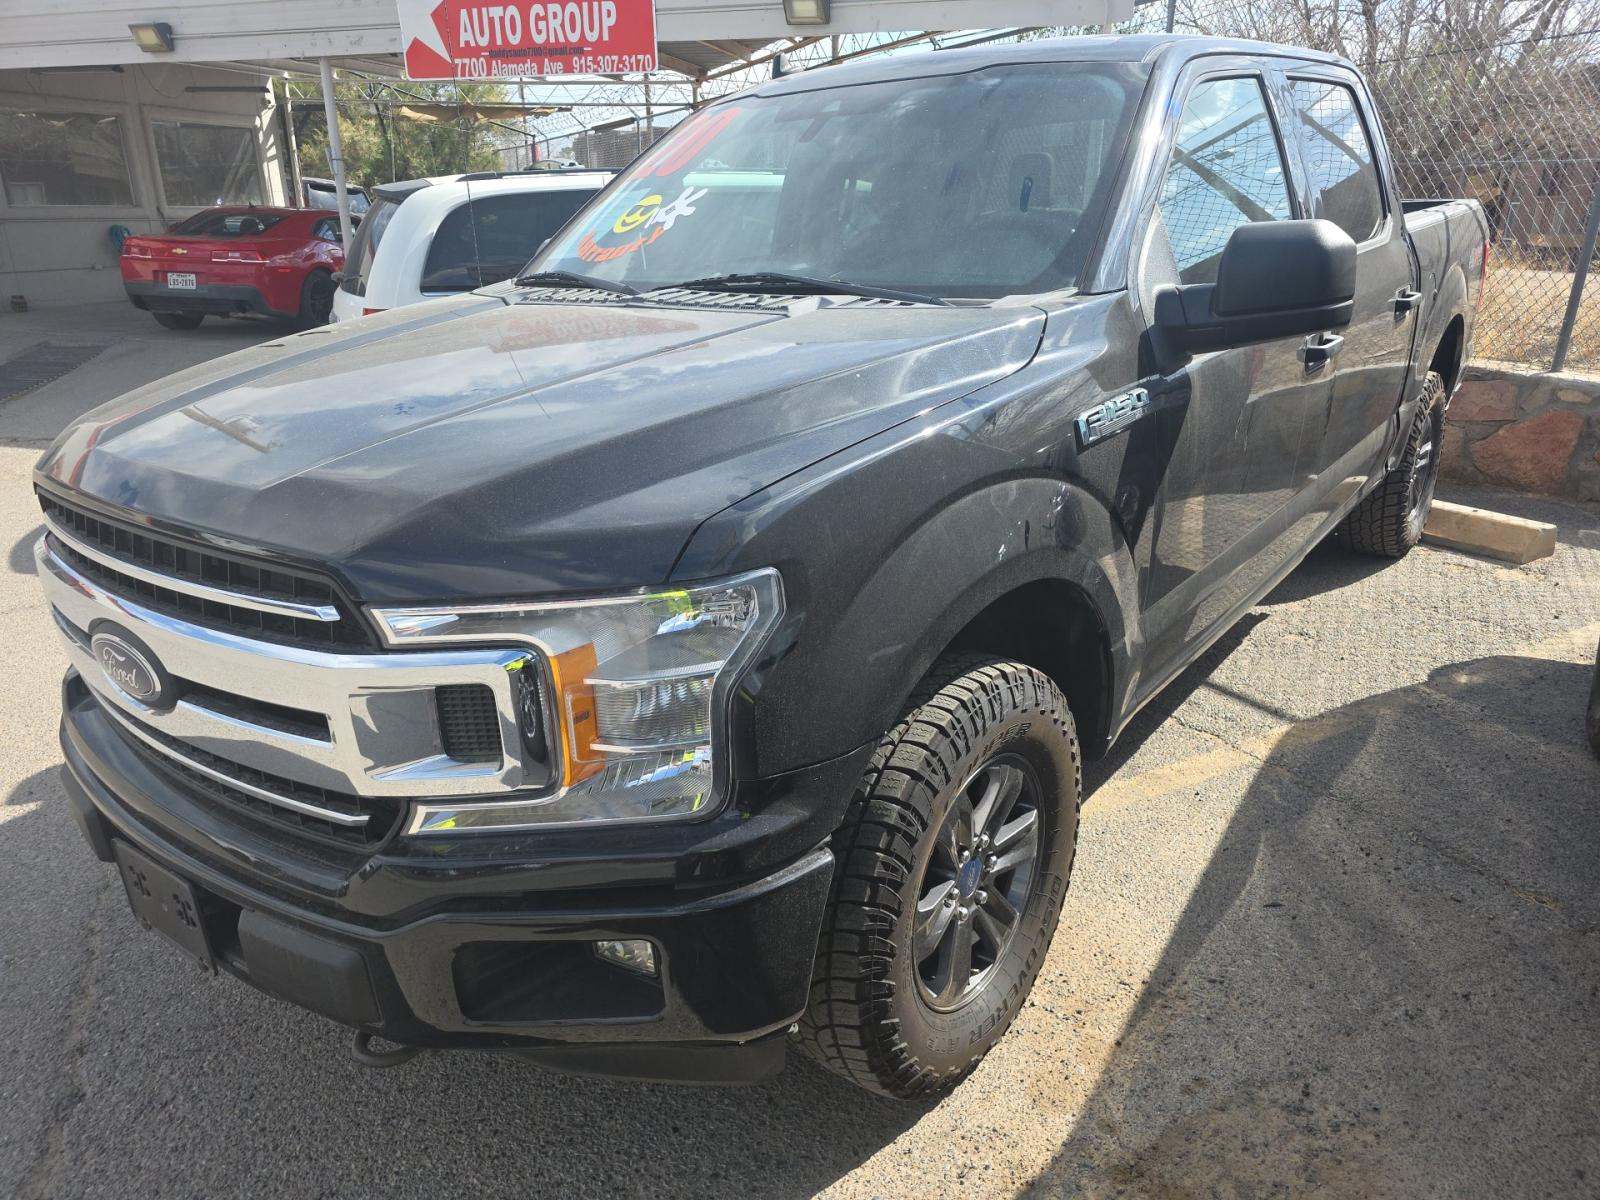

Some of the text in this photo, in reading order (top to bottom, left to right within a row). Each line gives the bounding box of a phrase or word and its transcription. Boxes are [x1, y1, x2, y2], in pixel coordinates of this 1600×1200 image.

[459, 0, 617, 48] AUTO GROUP
[454, 54, 652, 78] 7700 Alameda Ave 915-307-3170
[103, 647, 138, 689] Ford
